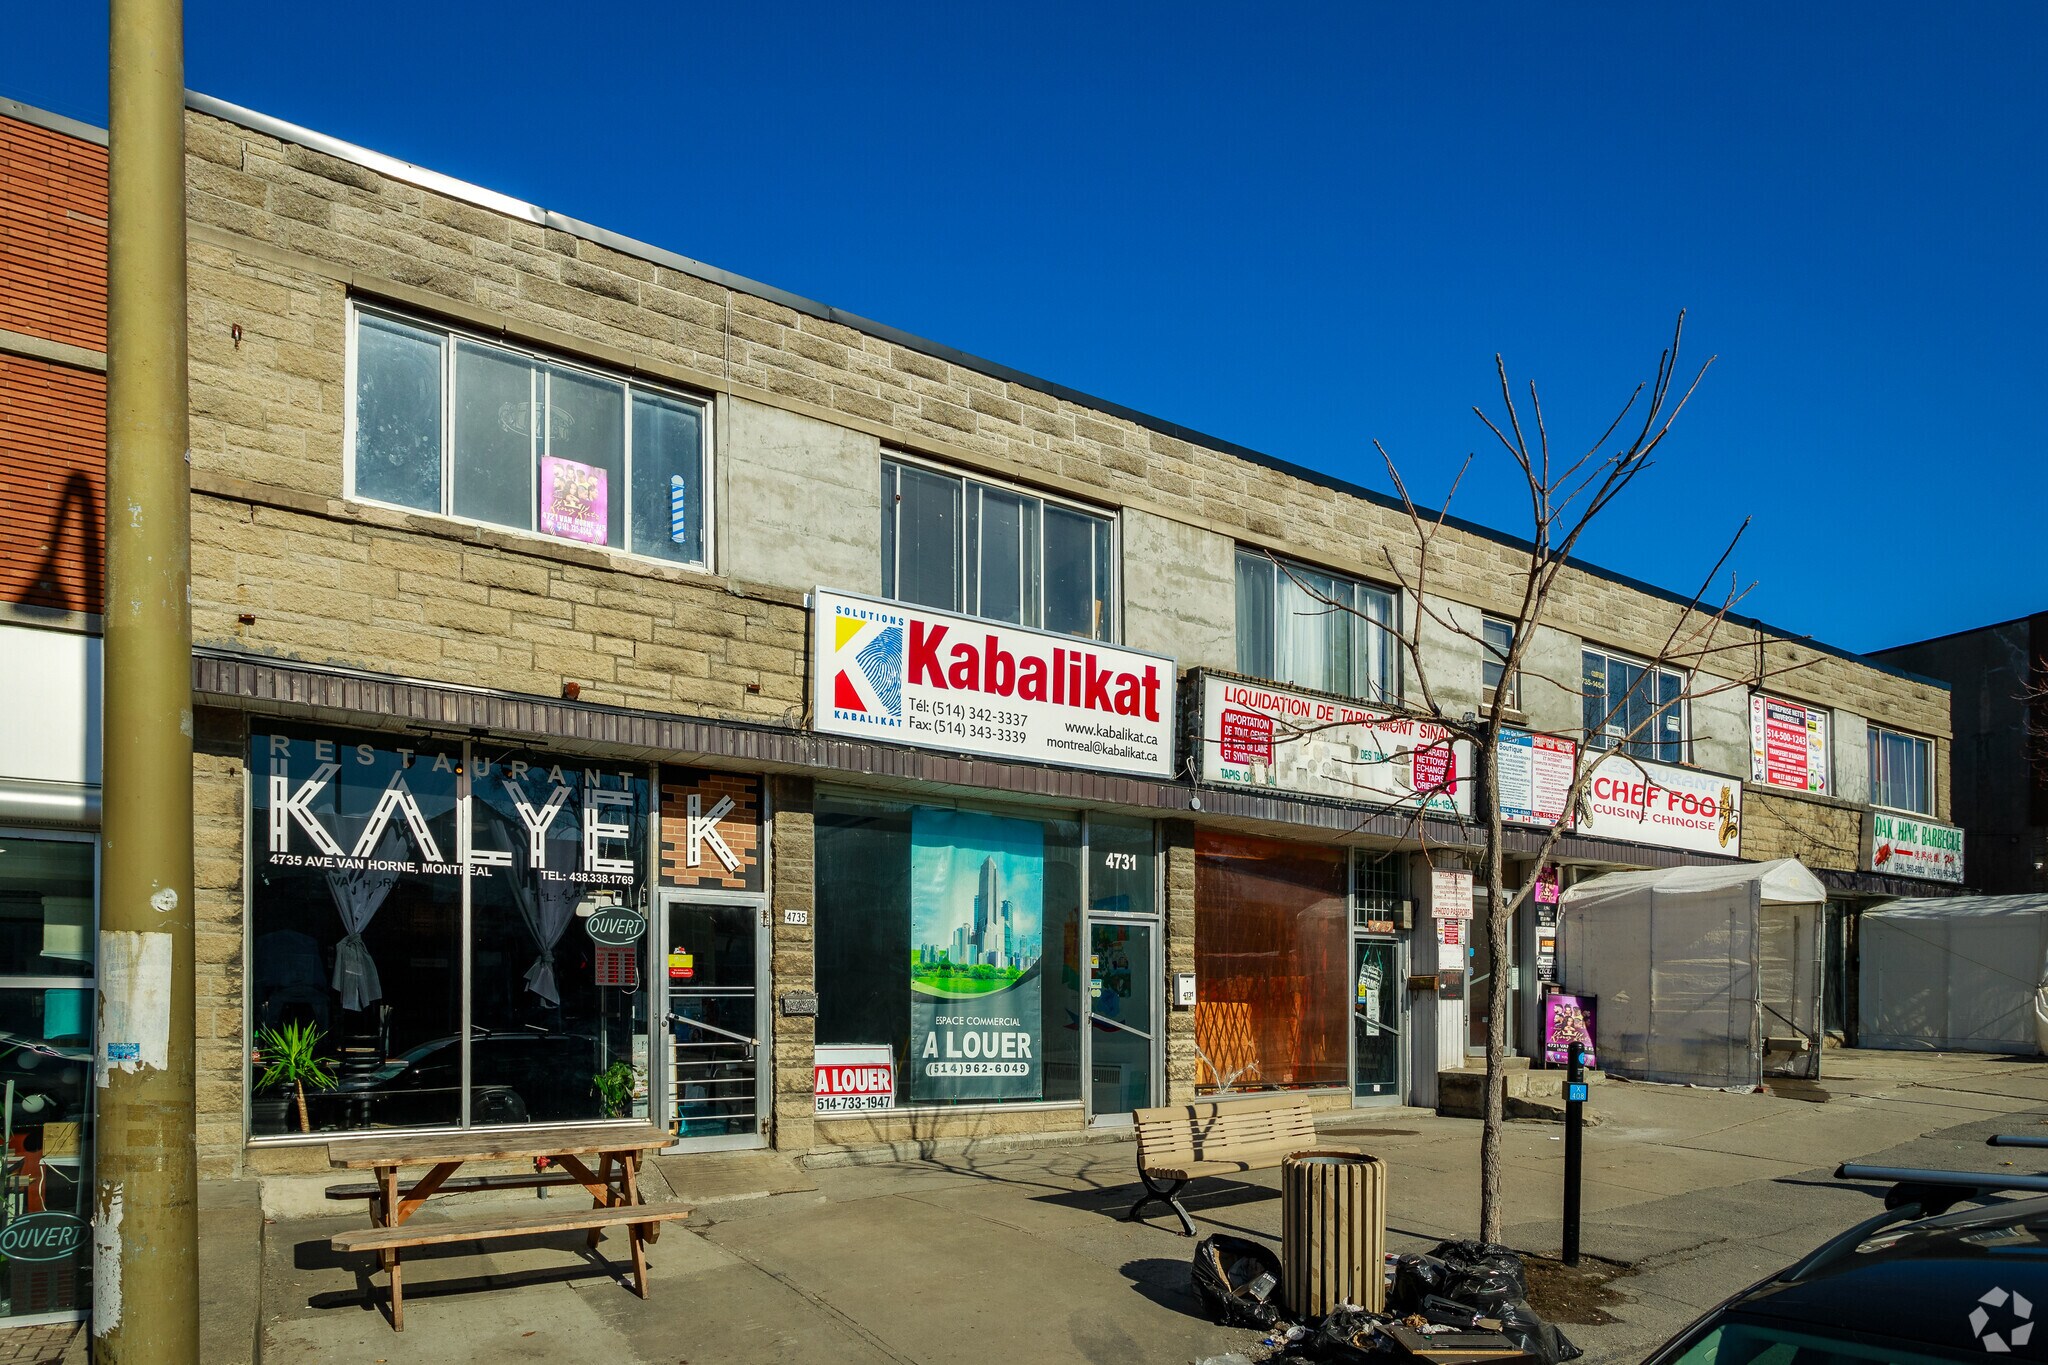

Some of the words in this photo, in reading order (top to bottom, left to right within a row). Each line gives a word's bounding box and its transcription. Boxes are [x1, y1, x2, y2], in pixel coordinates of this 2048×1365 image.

[836, 605, 904, 626] SOLUTIONS
[908, 619, 1160, 723] Kabalikat
[909, 697, 929, 713] Tél:
[932, 701, 965, 720] (514)
[969, 706, 1028, 727] 342-3337
[1224, 686, 1310, 718] LIQUIDATION
[1316, 705, 1334, 721] DE
[1341, 709, 1374, 729] TAPIS
[834, 710, 902, 727] KABALIKAT
[1224, 713, 1270, 730] IMPORTATION
[909, 716, 932, 731] Fax:
[934, 719, 966, 737] (514)
[969, 725, 1027, 744] 343-3339
[1065, 723, 1158, 745] www.kabalikat.ca
[1224, 725, 1233, 735] DE
[1767, 729, 1806, 746] 514-500-1243
[1047, 737, 1158, 761] montreal@kabalikat.ca
[1224, 750, 1231, 760] ET
[1360, 749, 1372, 760] DES
[270, 734, 634, 791] RESTAURANT
[1220, 768, 1241, 781] TAPIS
[1417, 772, 1425, 780] DE
[1594, 777, 1661, 808] CHEF
[1667, 790, 1717, 818] FOO
[269, 758, 634, 874] KALYE
[1593, 803, 1648, 822] CUISINE
[1652, 814, 1716, 831] CHINOISE
[687, 794, 741, 874] K
[1875, 816, 1894, 840] DAK
[1921, 826, 1962, 852] BARBECUE
[270, 854, 302, 866] 4735
[336, 858, 364, 870] VAN
[367, 860, 419, 875] HORNE,
[1105, 852, 1136, 871] 4731
[541, 870, 567, 882] TEL:
[569, 872, 634, 886] 438.338.1769
[589, 918, 642, 934] OUVERT
[786, 910, 806, 923] 4735
[935, 1016, 964, 1025] ESPACE
[966, 1017, 1021, 1026] COMMERCIAL
[922, 1031, 939, 1059] A
[946, 1031, 1033, 1059] LOUER
[815, 1069, 830, 1092] A
[832, 1068, 891, 1092] LOUER
[929, 1063, 1026, 1076] (514)962-6049
[817, 1096, 891, 1110] 514-733-1947
[1572, 1092, 1585, 1100] 408
[2, 1226, 84, 1250] OUVERT
